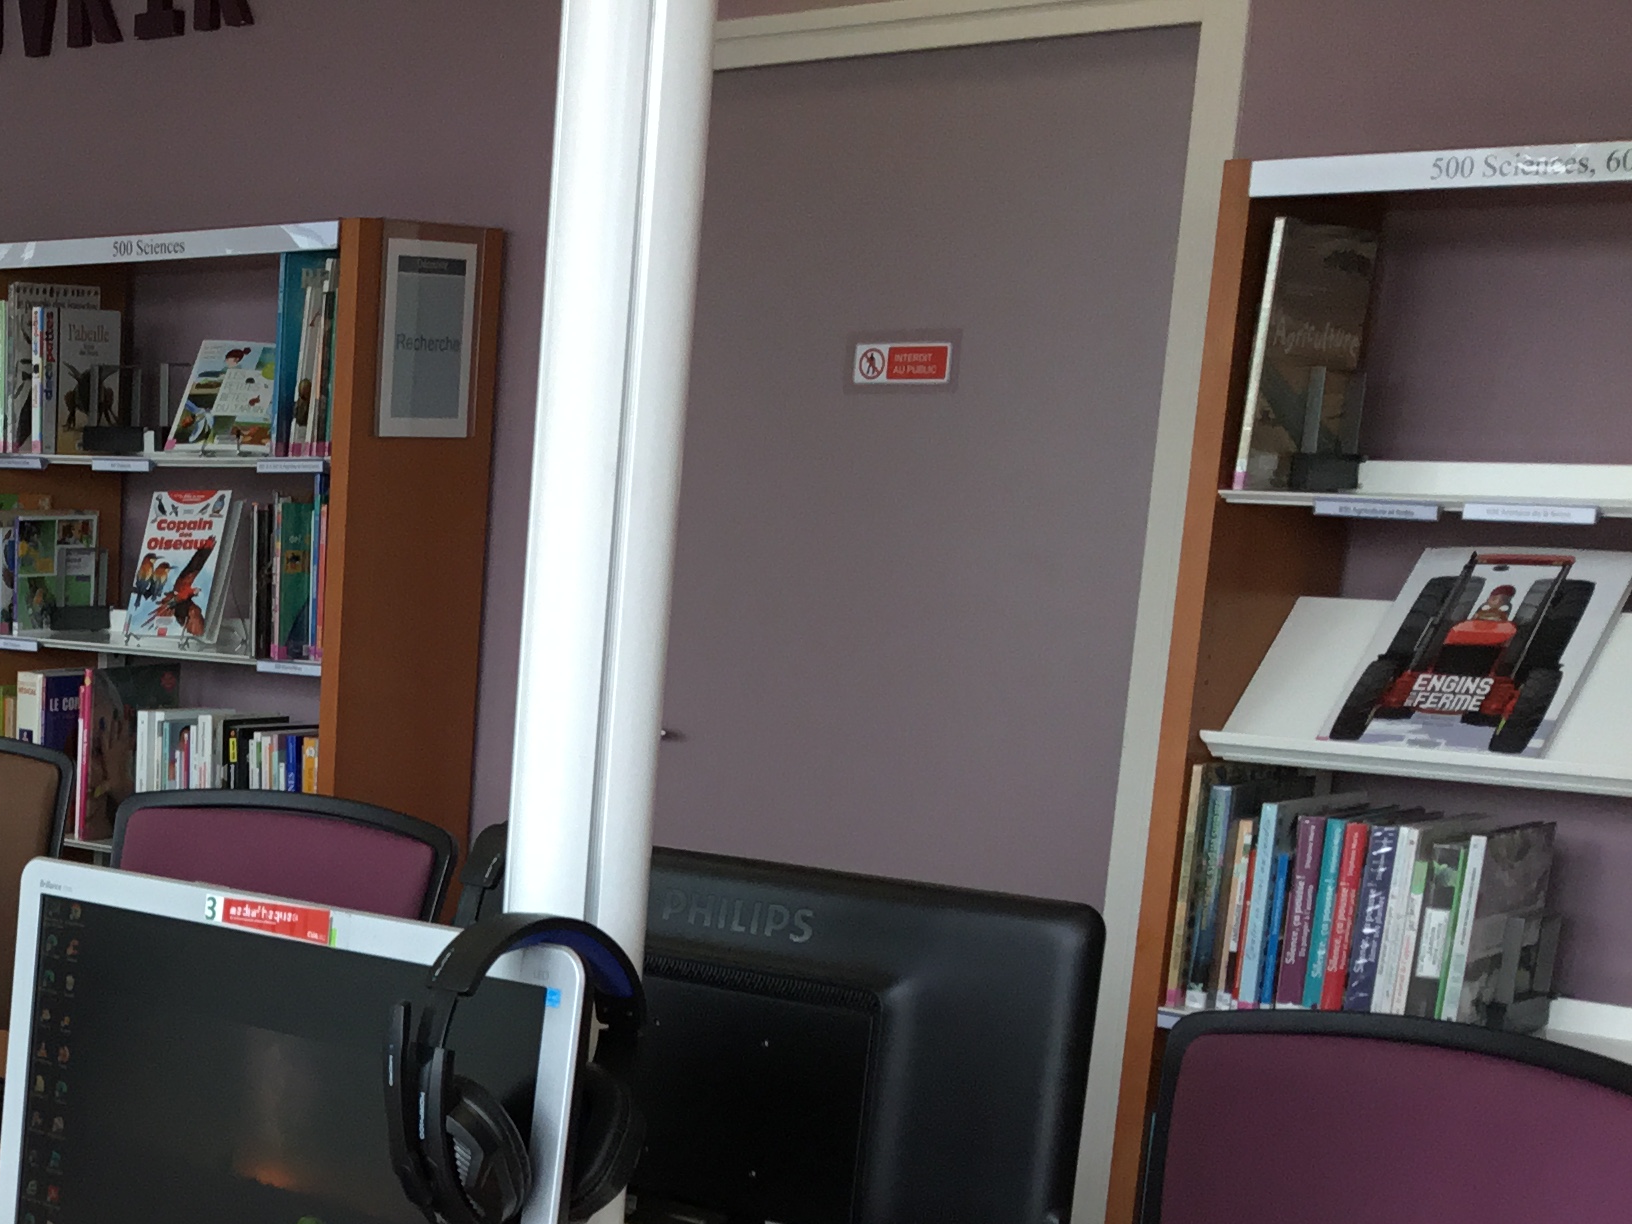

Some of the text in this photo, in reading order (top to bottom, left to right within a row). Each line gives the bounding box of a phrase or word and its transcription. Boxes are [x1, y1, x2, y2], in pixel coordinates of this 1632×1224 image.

[1431, 156, 1474, 180] 500
[113, 240, 185, 257] 500 Sciences
[396, 333, 460, 352] Recherche
[894, 353, 933, 363] INTERDIT
[893, 365, 937, 375] AU PUBLIC
[157, 518, 214, 532] Copain
[1413, 673, 1495, 695] ENGINS
[49, 698, 60, 713] LE
[1413, 691, 1485, 712] FERME
[205, 896, 217, 920] 3
[662, 888, 816, 944] PHILIPS
